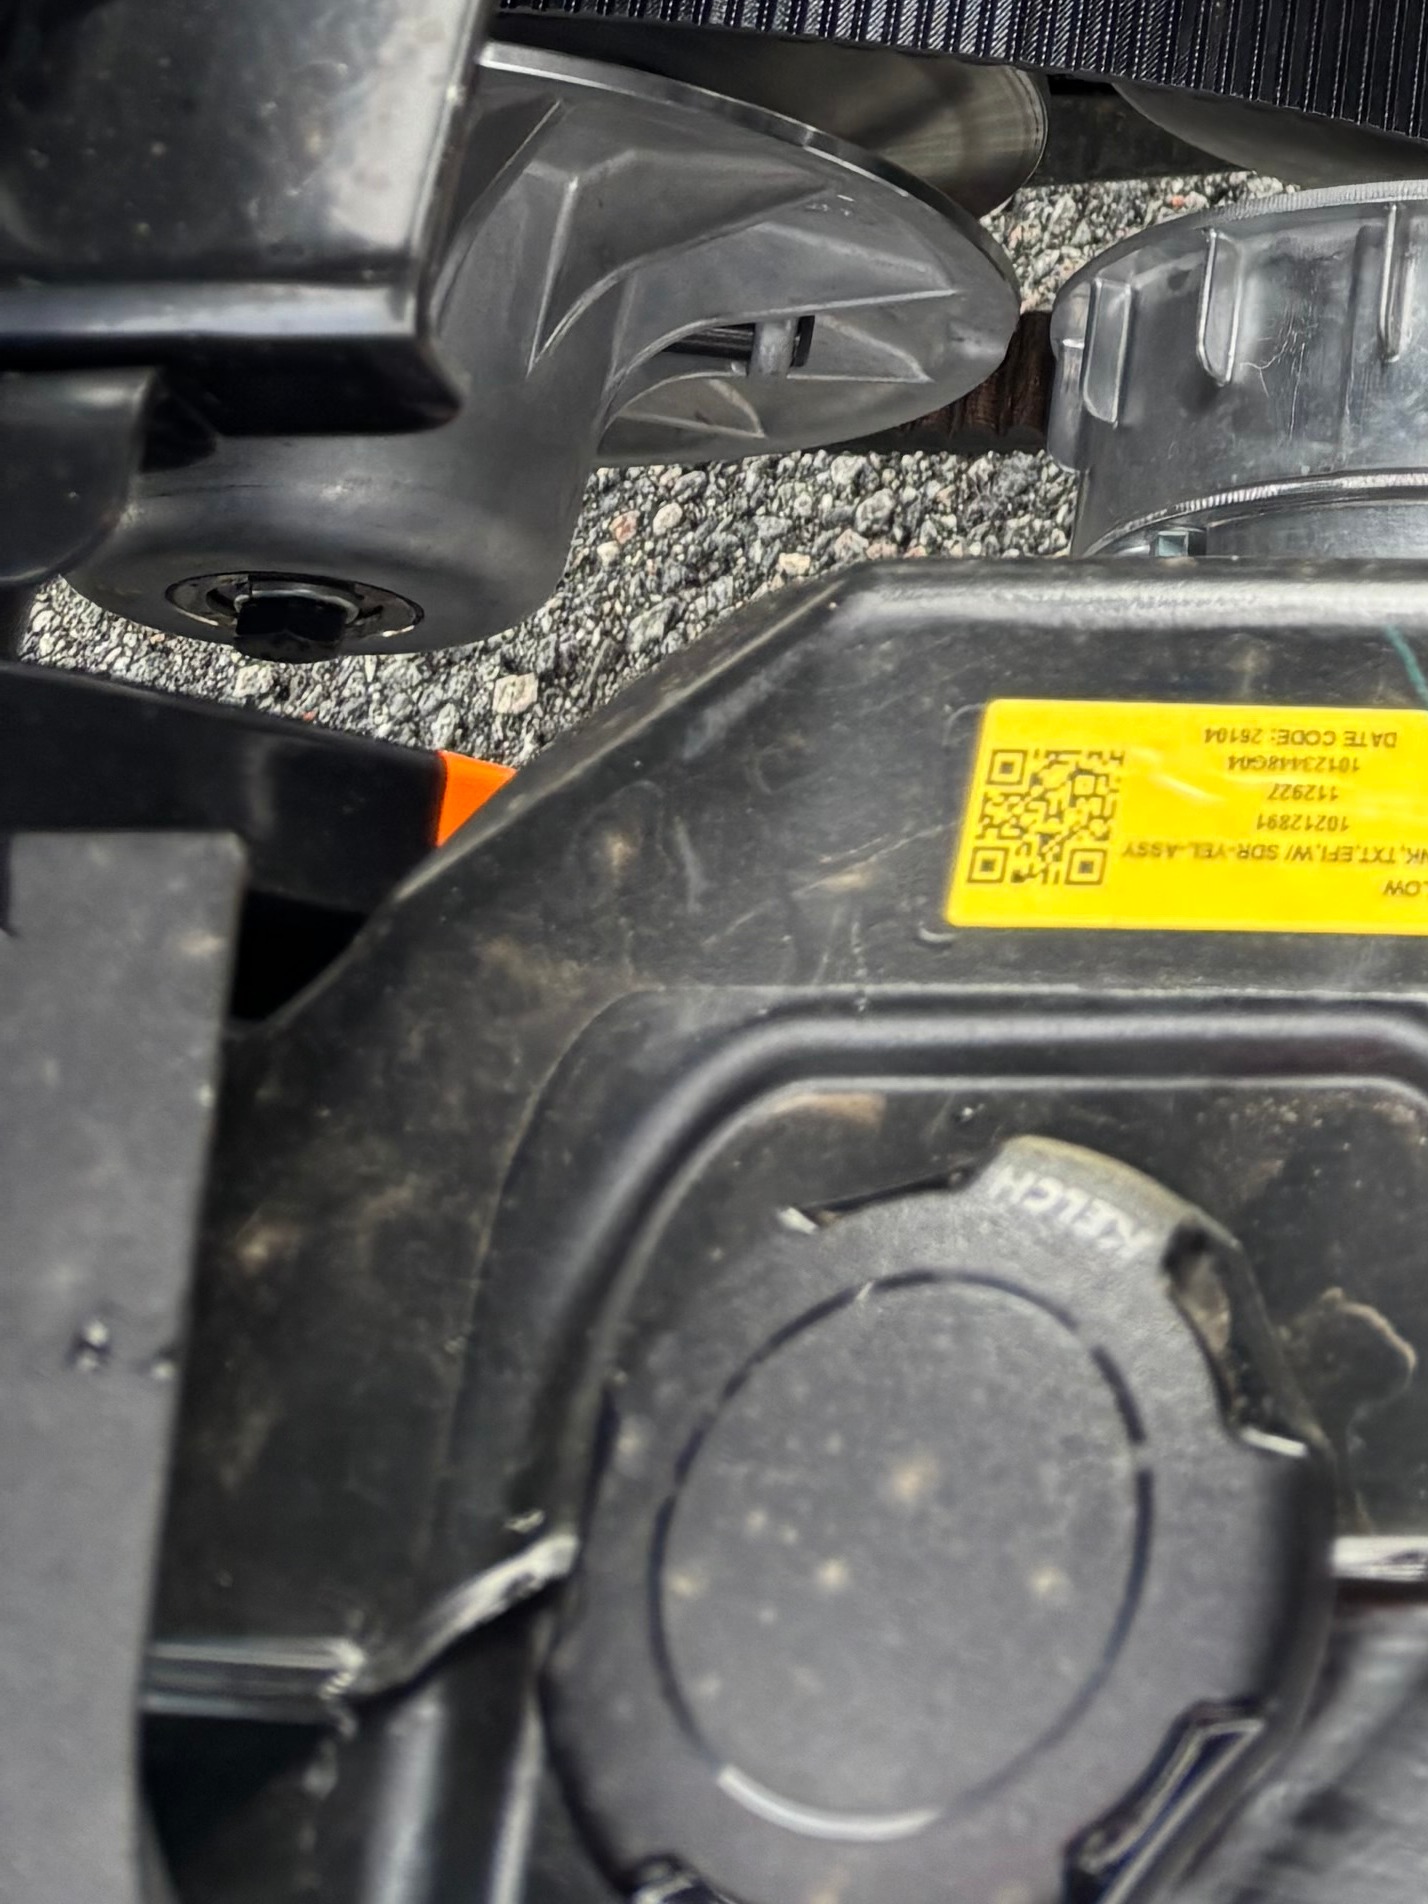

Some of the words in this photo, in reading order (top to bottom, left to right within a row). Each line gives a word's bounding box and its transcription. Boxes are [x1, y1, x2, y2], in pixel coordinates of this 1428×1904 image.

[1269, 727, 1336, 747] CODE:
[1342, 728, 1397, 748] DATE
[1265, 782, 1339, 801] 112927
[1254, 812, 1350, 832] 10212891
[981, 1164, 1148, 1256] KELCH
